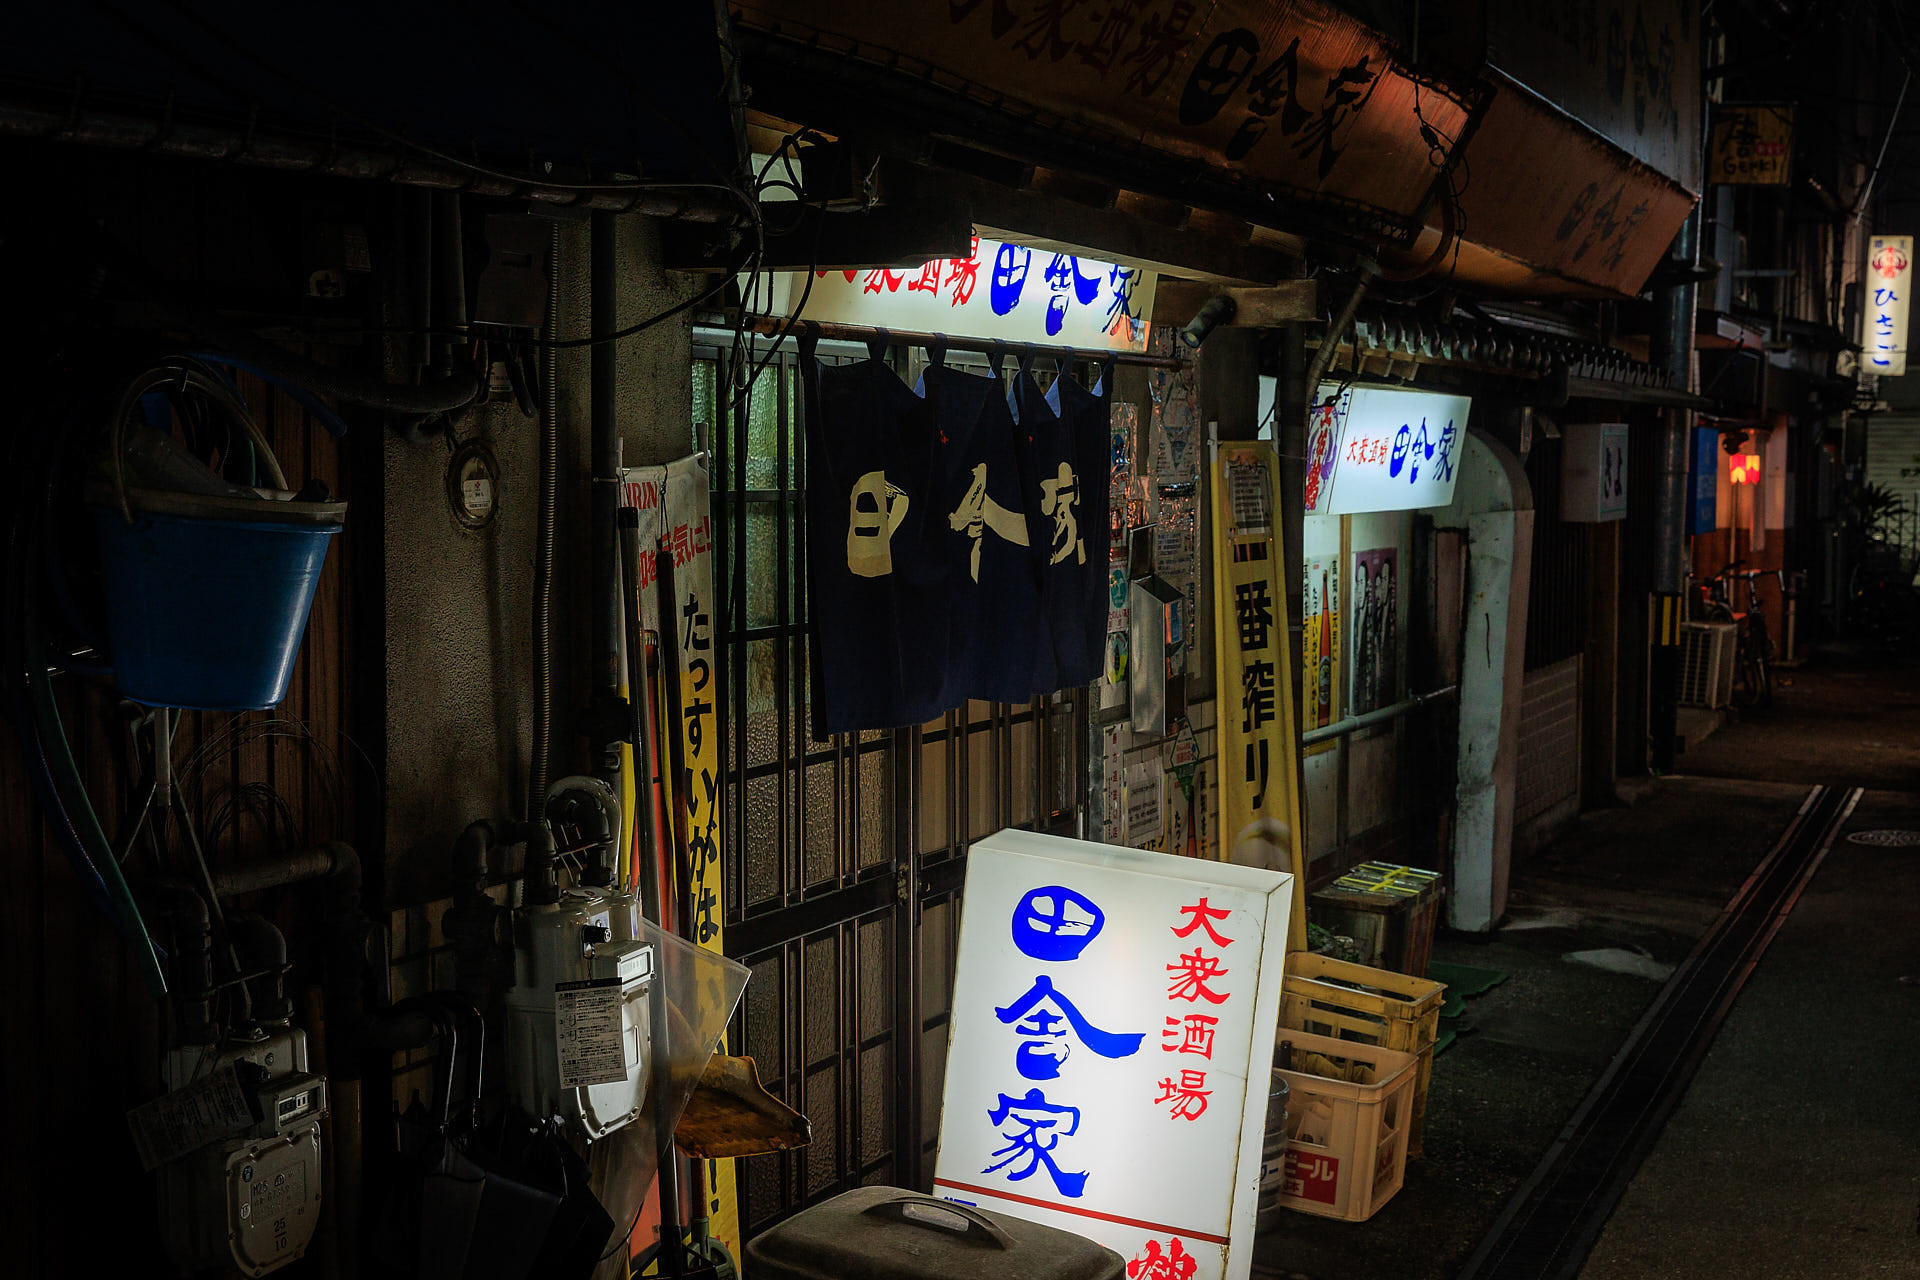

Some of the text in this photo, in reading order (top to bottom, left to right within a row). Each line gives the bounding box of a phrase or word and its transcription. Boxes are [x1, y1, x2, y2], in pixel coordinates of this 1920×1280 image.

[1389, 416, 1457, 485] 田舎家
[1232, 541, 1276, 811] 一番搾り
[982, 885, 1146, 1199] 田舎家
[1153, 897, 1234, 1121] 大衆酒場
